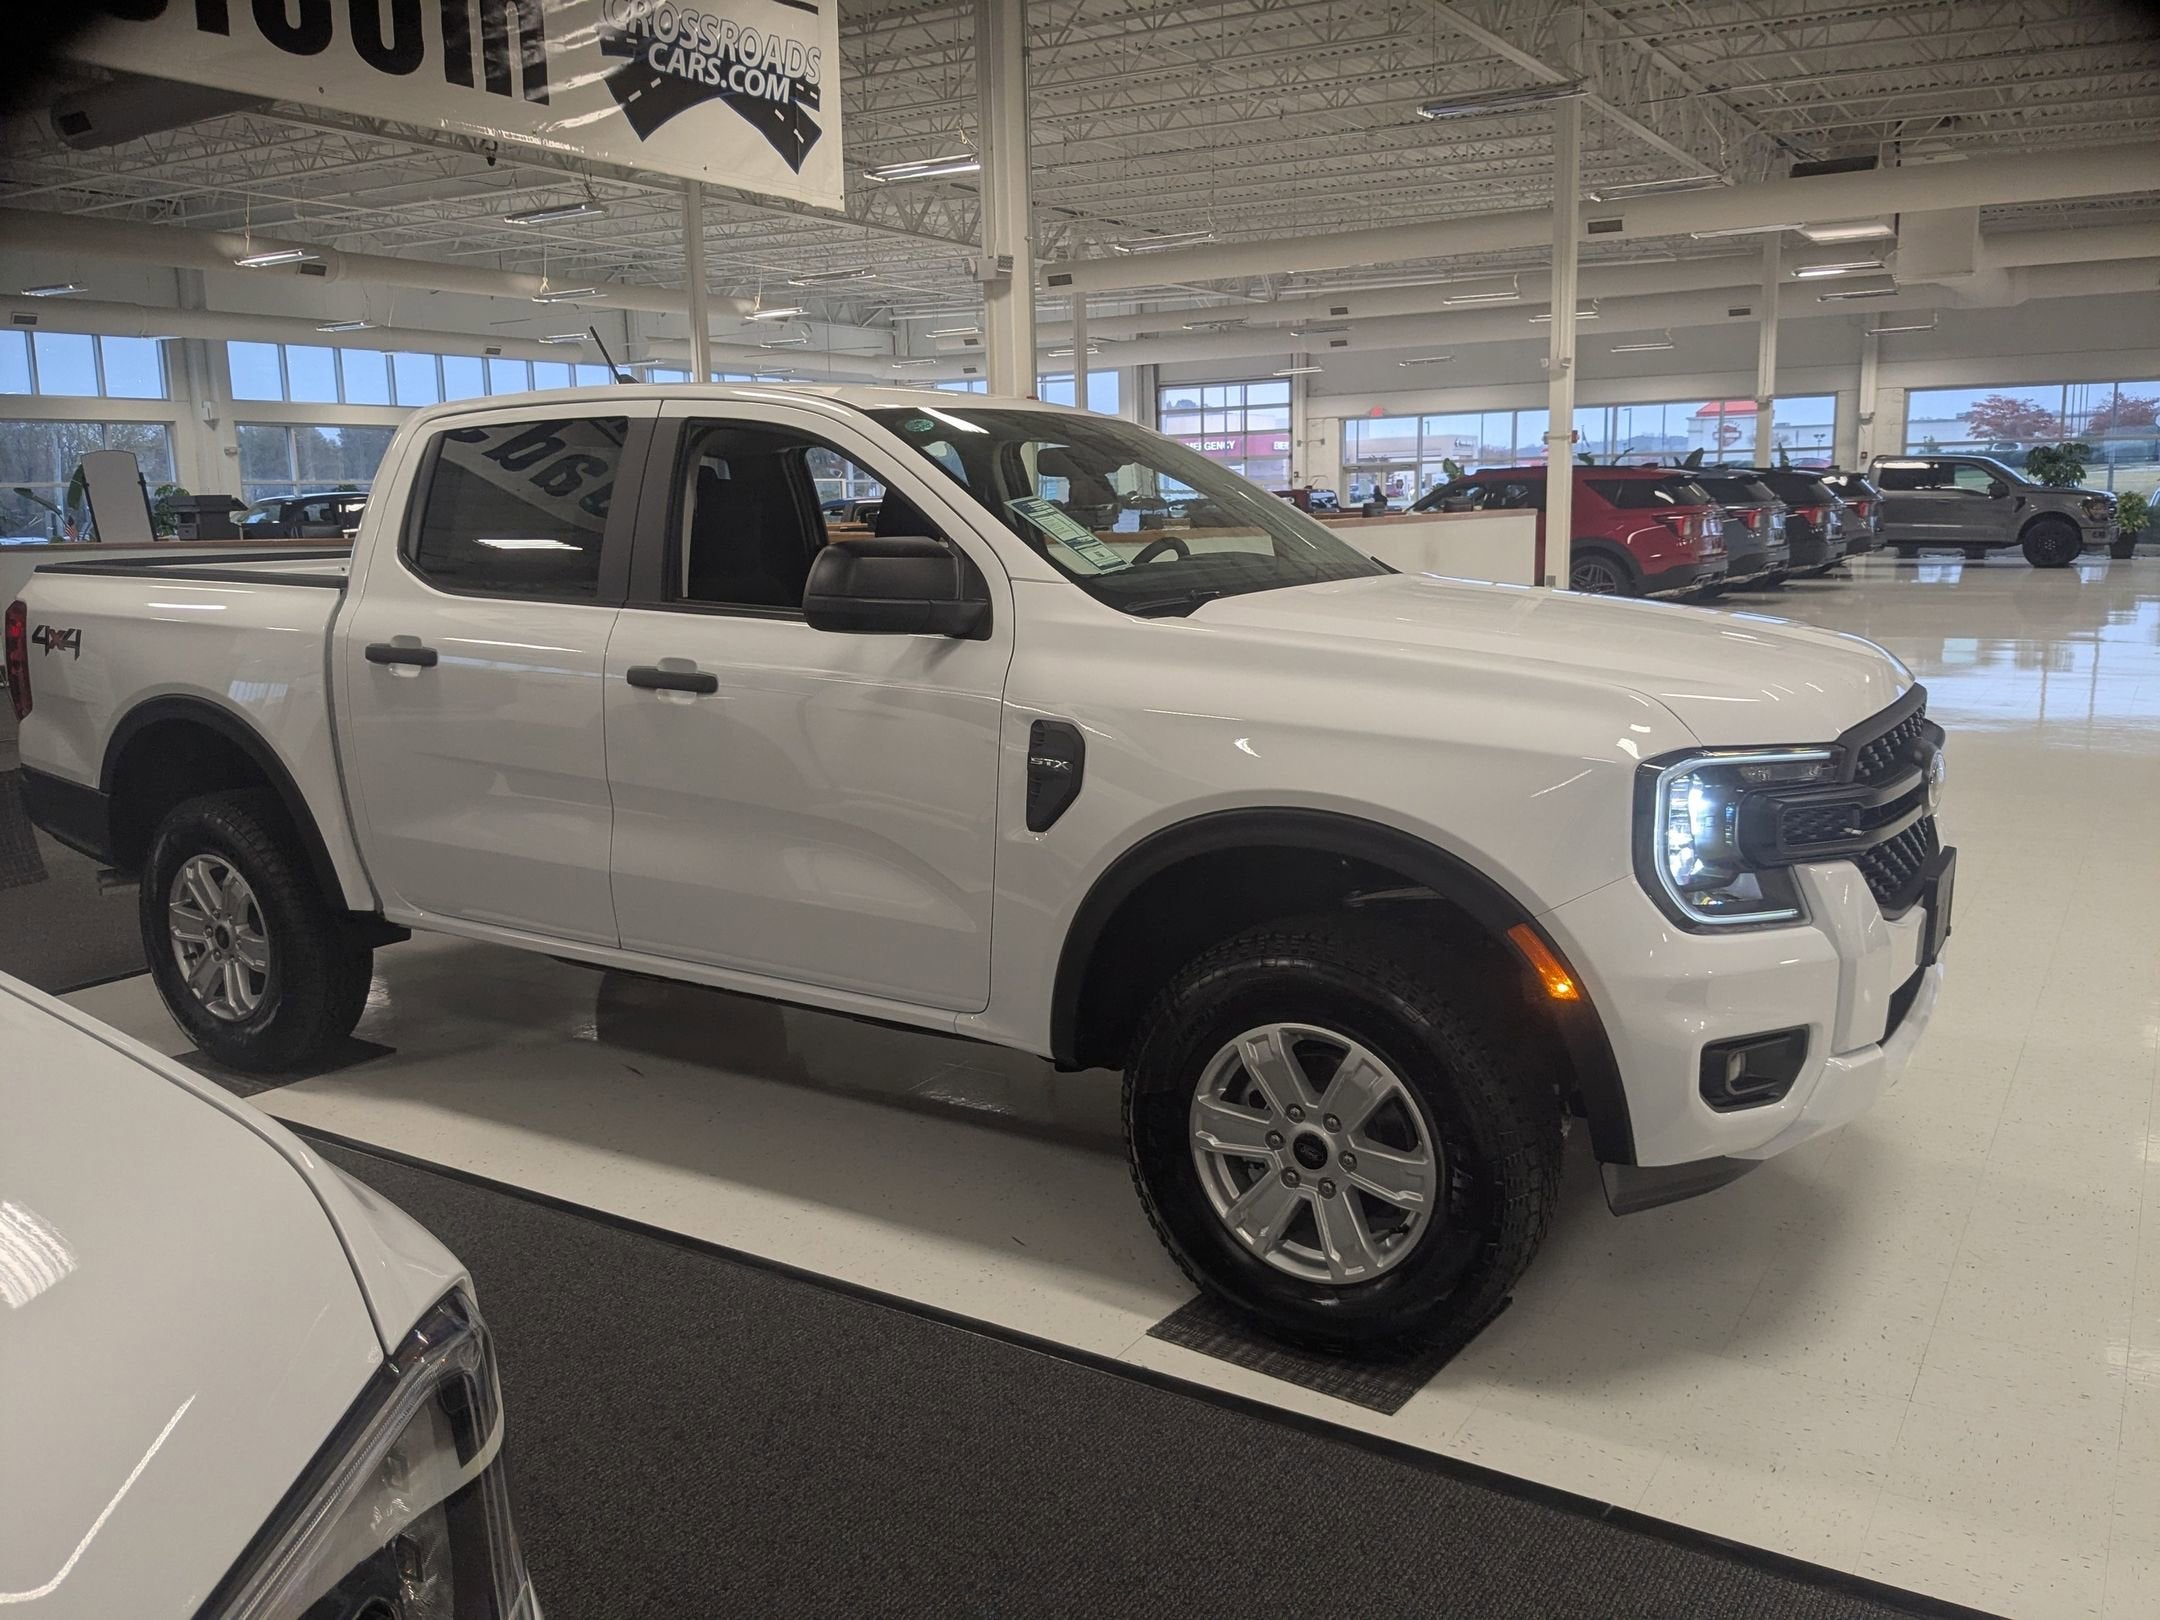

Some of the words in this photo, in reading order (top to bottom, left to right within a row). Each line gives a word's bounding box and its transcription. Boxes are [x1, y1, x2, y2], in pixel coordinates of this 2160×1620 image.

[602, 0, 822, 85] CROSSROADS
[648, 42, 791, 104] CARS.COM
[32, 624, 82, 661] 4x4
[1030, 757, 1073, 773] STX
